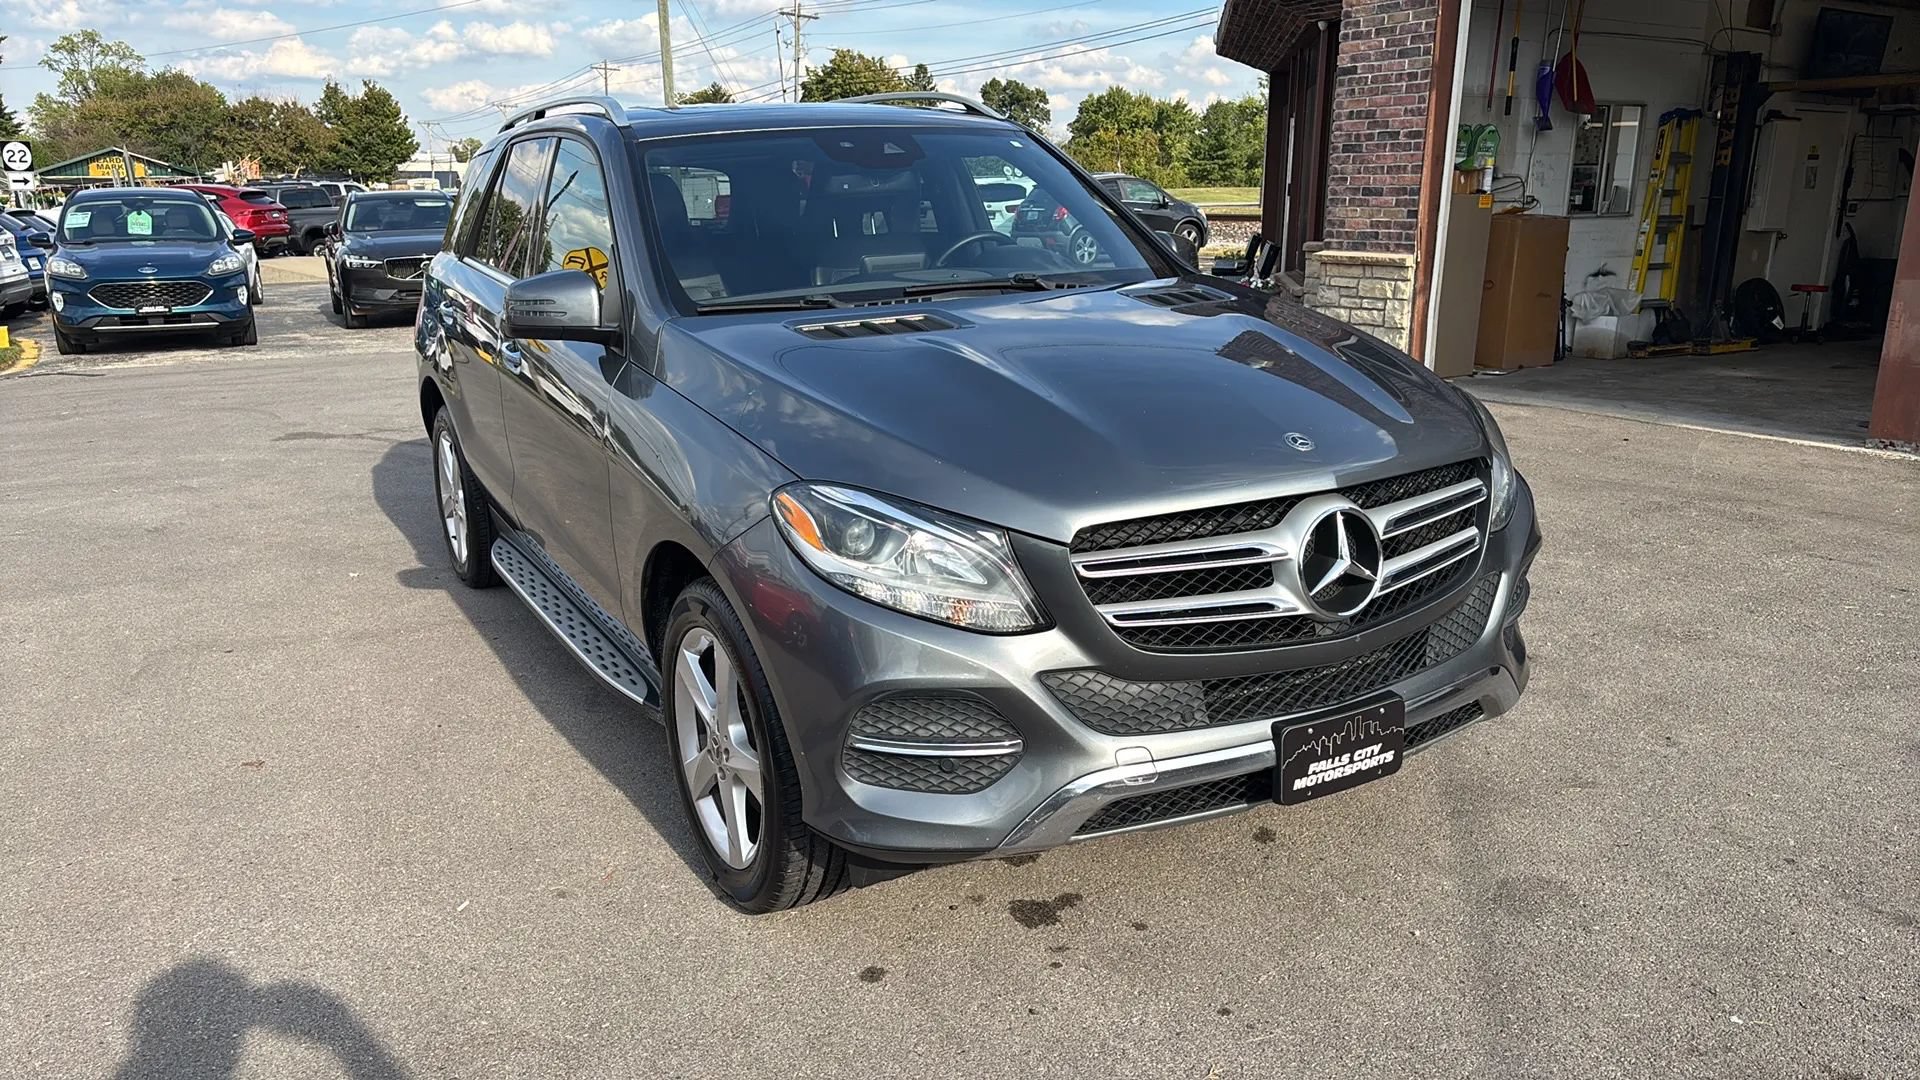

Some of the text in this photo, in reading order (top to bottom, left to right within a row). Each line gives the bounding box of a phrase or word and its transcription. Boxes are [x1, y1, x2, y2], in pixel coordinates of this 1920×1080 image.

[6, 149, 28, 163] 22
[1292, 750, 1395, 791] MOTORSPORTS
[1308, 743, 1383, 775] FALLS CITY
